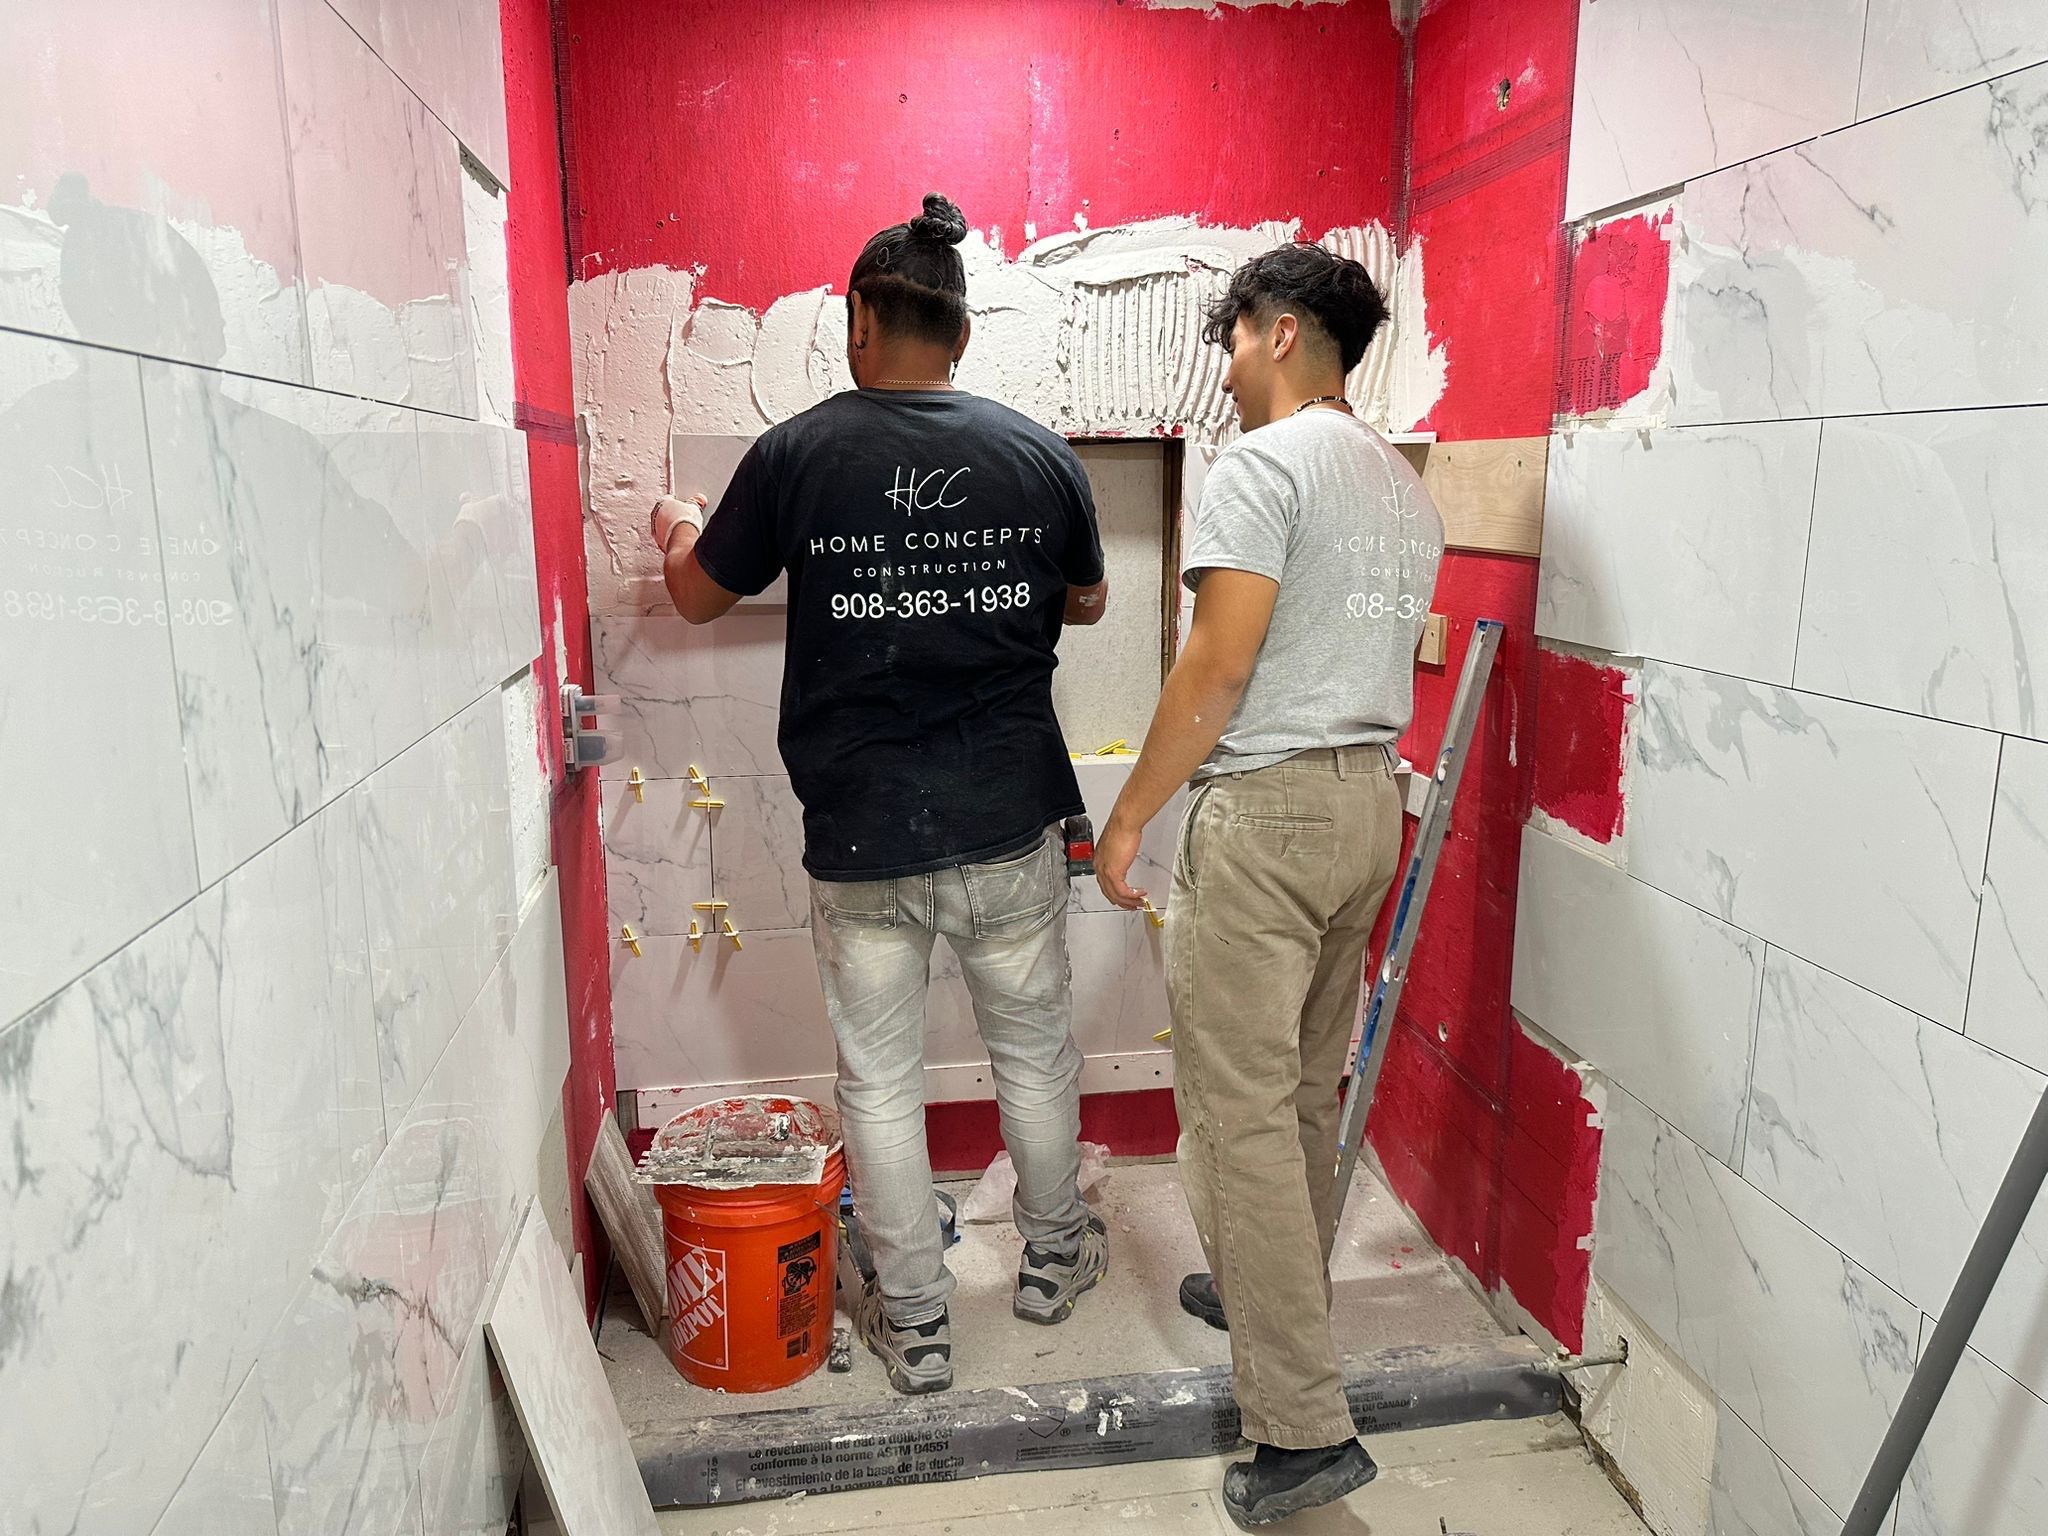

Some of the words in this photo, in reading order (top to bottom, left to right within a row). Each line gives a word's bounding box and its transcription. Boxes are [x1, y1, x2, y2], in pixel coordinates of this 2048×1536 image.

[884, 465, 971, 517] HCC
[810, 534, 886, 556] HOME
[904, 526, 1044, 551] CONCEPTS
[853, 558, 1007, 579] CONSTRUCTION
[830, 581, 1031, 620] 908-363-1938
[667, 1247, 725, 1320] OME
[749, 1455, 808, 1472] conforme
[876, 1444, 912, 1460] ASTM
[834, 1466, 850, 1481] de
[852, 1465, 864, 1480] la
[866, 1461, 895, 1478] base
[896, 1461, 913, 1475] de
[915, 1459, 927, 1473] la
